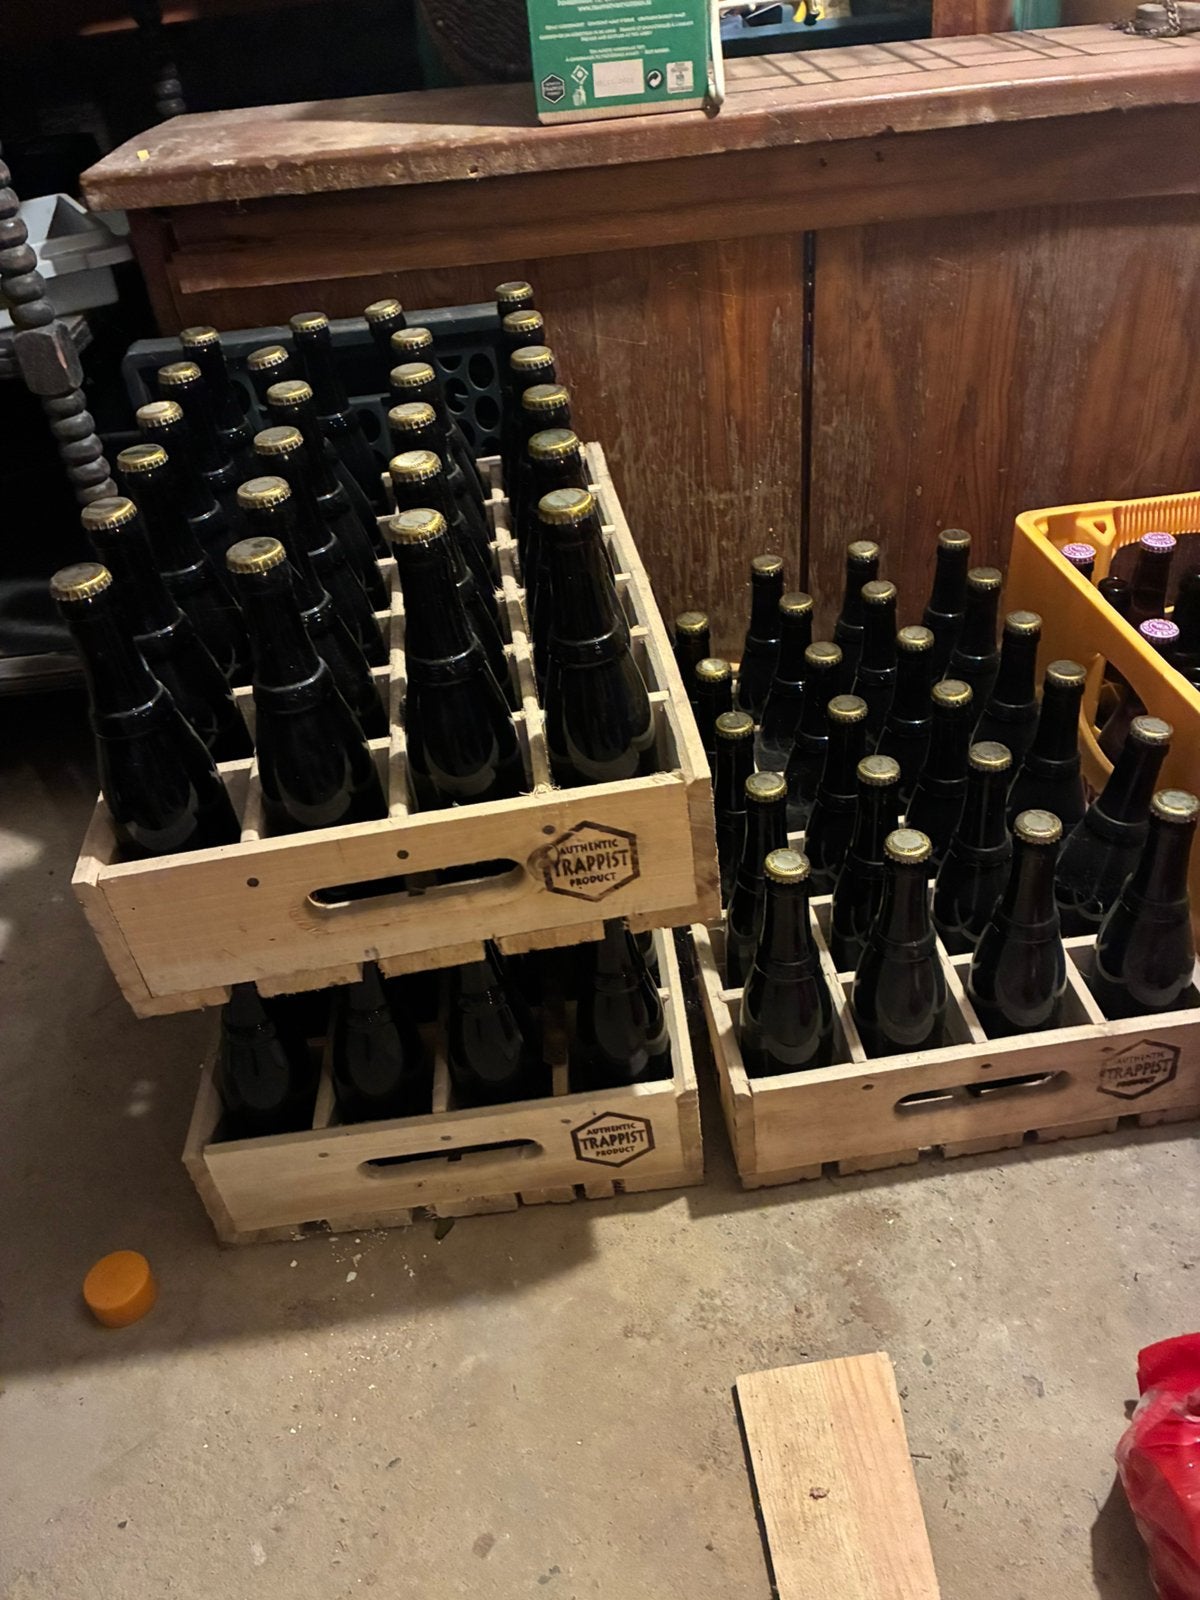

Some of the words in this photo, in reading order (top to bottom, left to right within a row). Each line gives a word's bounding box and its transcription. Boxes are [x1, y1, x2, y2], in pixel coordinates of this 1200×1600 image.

[560, 840, 618, 854] AUTHENTIC
[570, 873, 615, 886] PRODUCT
[587, 1123, 635, 1135] AUTHENTIC
[580, 1130, 644, 1150] TRAPPIST
[596, 1146, 634, 1156] PRODUCT
